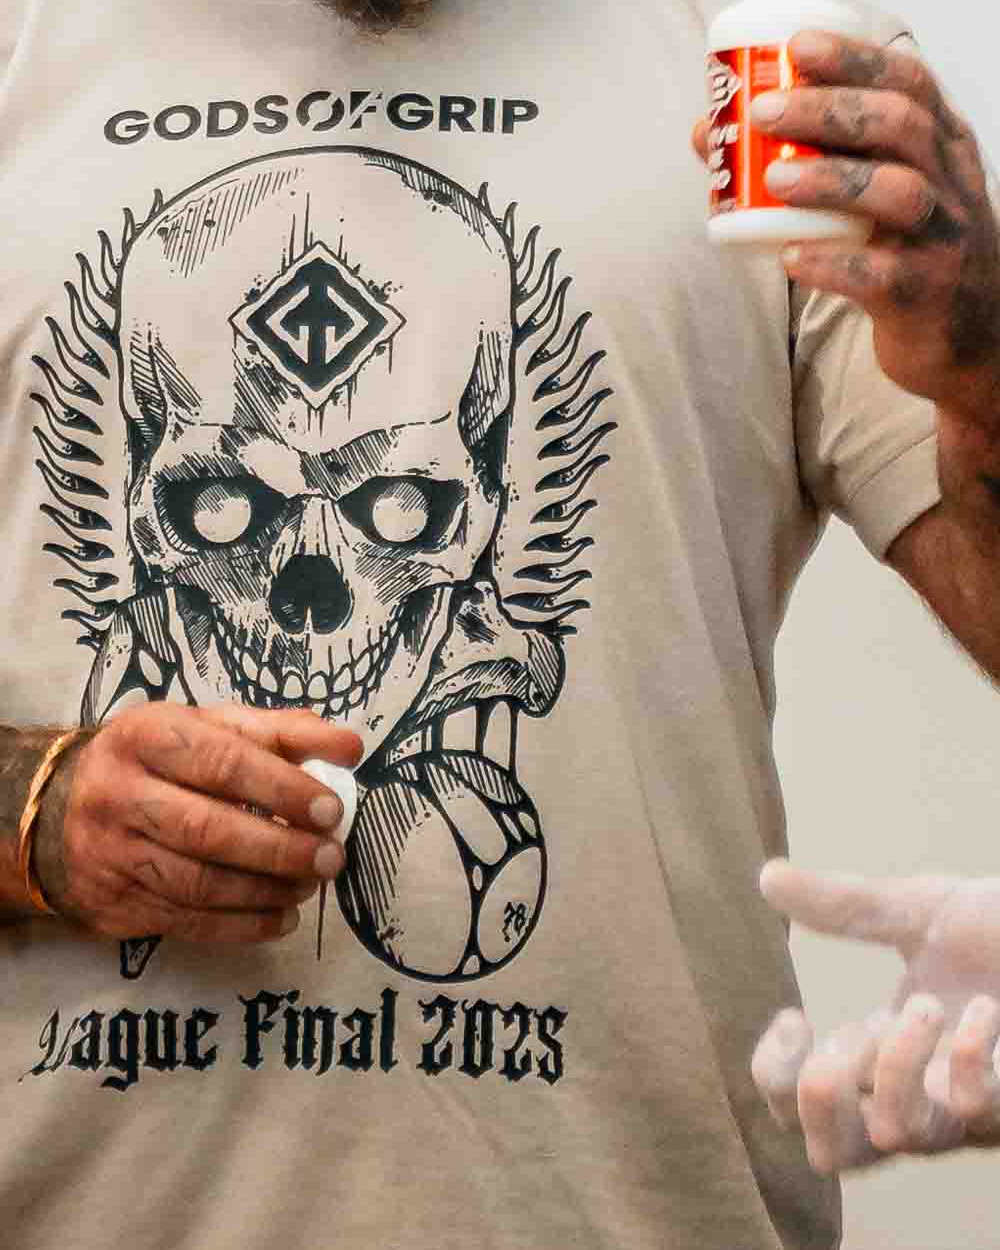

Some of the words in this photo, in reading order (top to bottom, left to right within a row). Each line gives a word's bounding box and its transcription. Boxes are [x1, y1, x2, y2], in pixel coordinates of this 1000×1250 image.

[103, 90, 539, 145] GODSOFGRIP
[238, 983, 398, 1076] Final
[416, 995, 568, 1086] 2025
